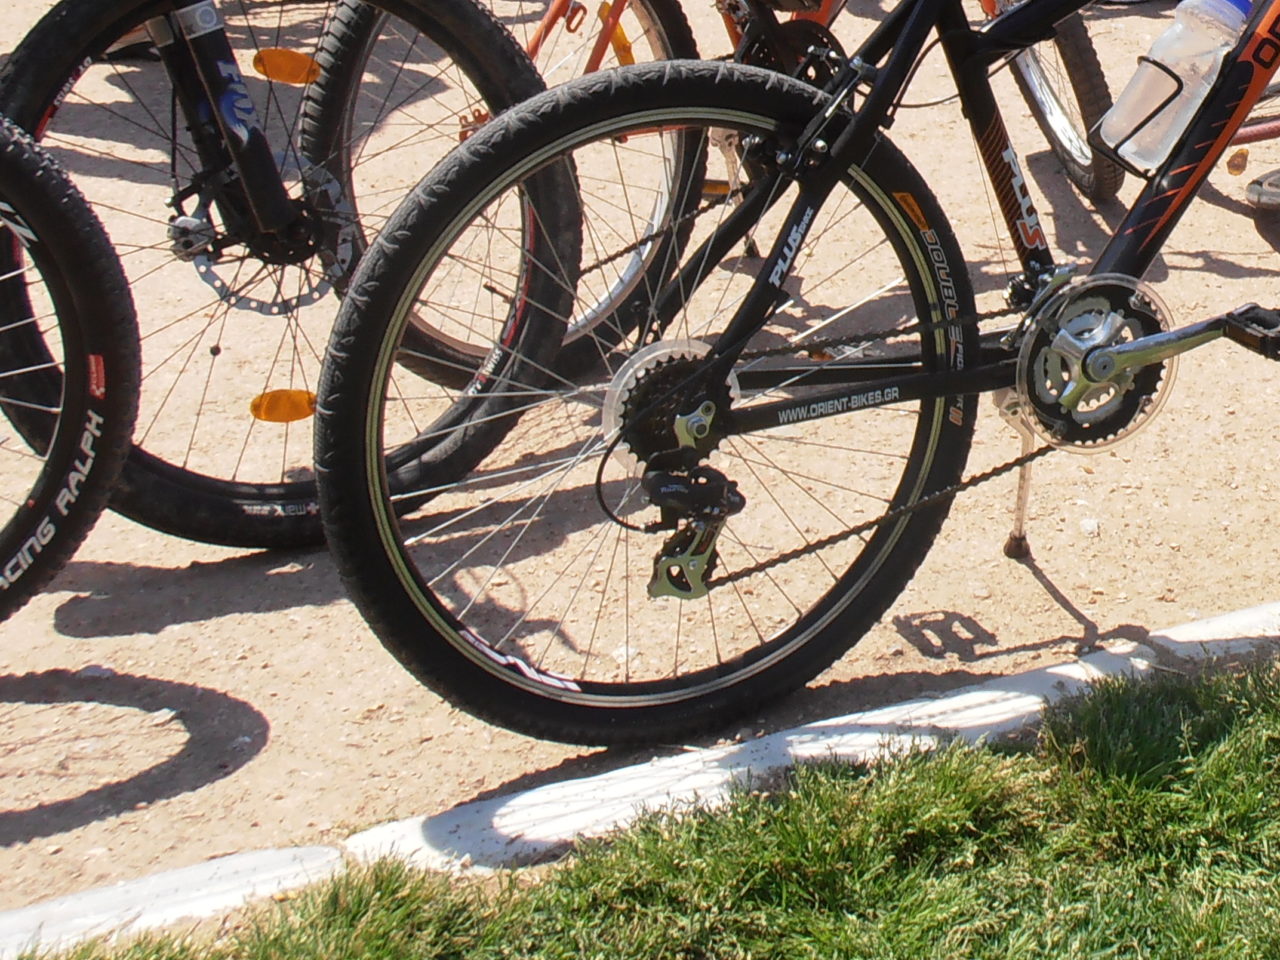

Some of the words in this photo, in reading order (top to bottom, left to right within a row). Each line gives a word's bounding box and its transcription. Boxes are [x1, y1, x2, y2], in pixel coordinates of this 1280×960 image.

[1001, 141, 1047, 251] PLUS
[768, 223, 802, 289] PLUS
[920, 228, 964, 344] DOUBLE
[777, 386, 900, 425] WWW.ORIENT-BIKES.GR
[54, 408, 105, 517] RALPH
